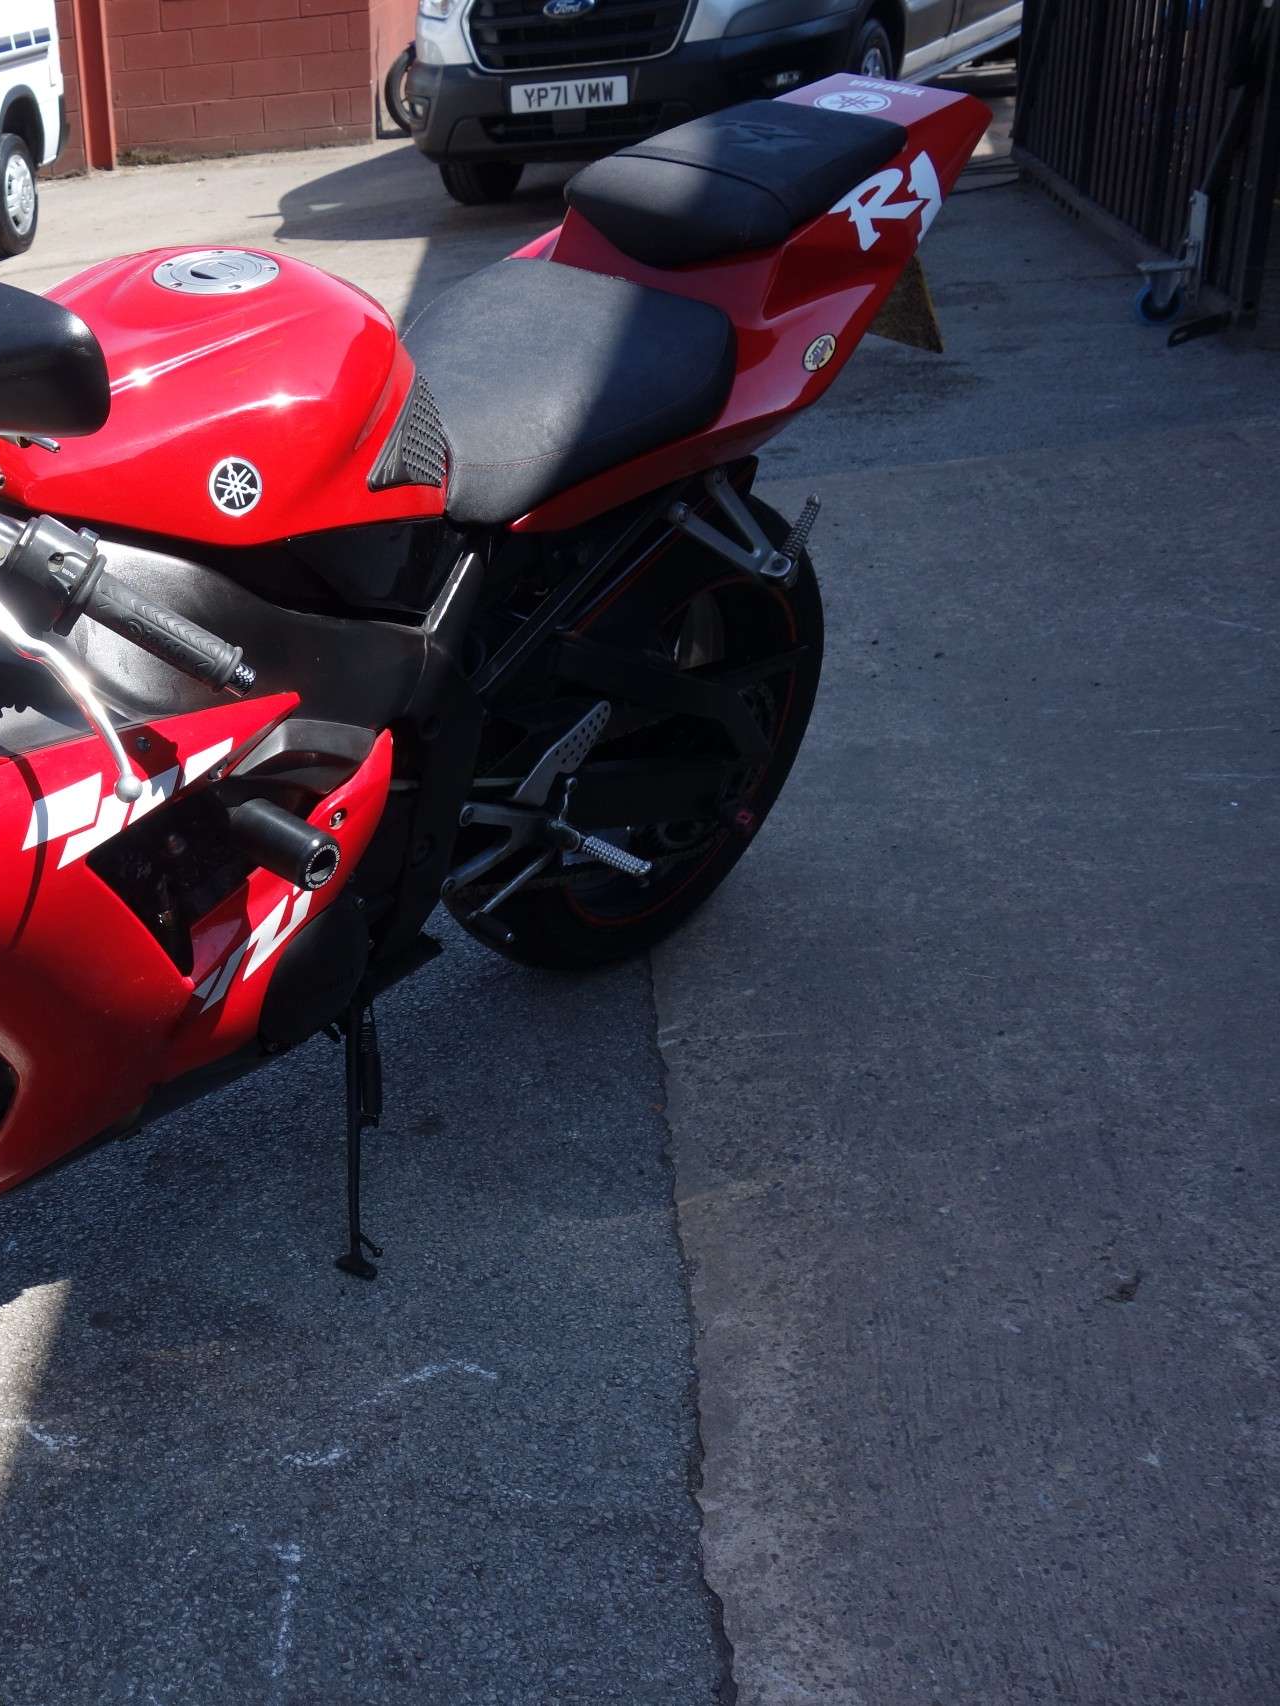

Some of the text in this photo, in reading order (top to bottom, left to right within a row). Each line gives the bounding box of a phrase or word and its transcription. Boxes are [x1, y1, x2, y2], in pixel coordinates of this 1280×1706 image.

[524, 81, 614, 109] YP71 VMW
[827, 149, 943, 251] R1
